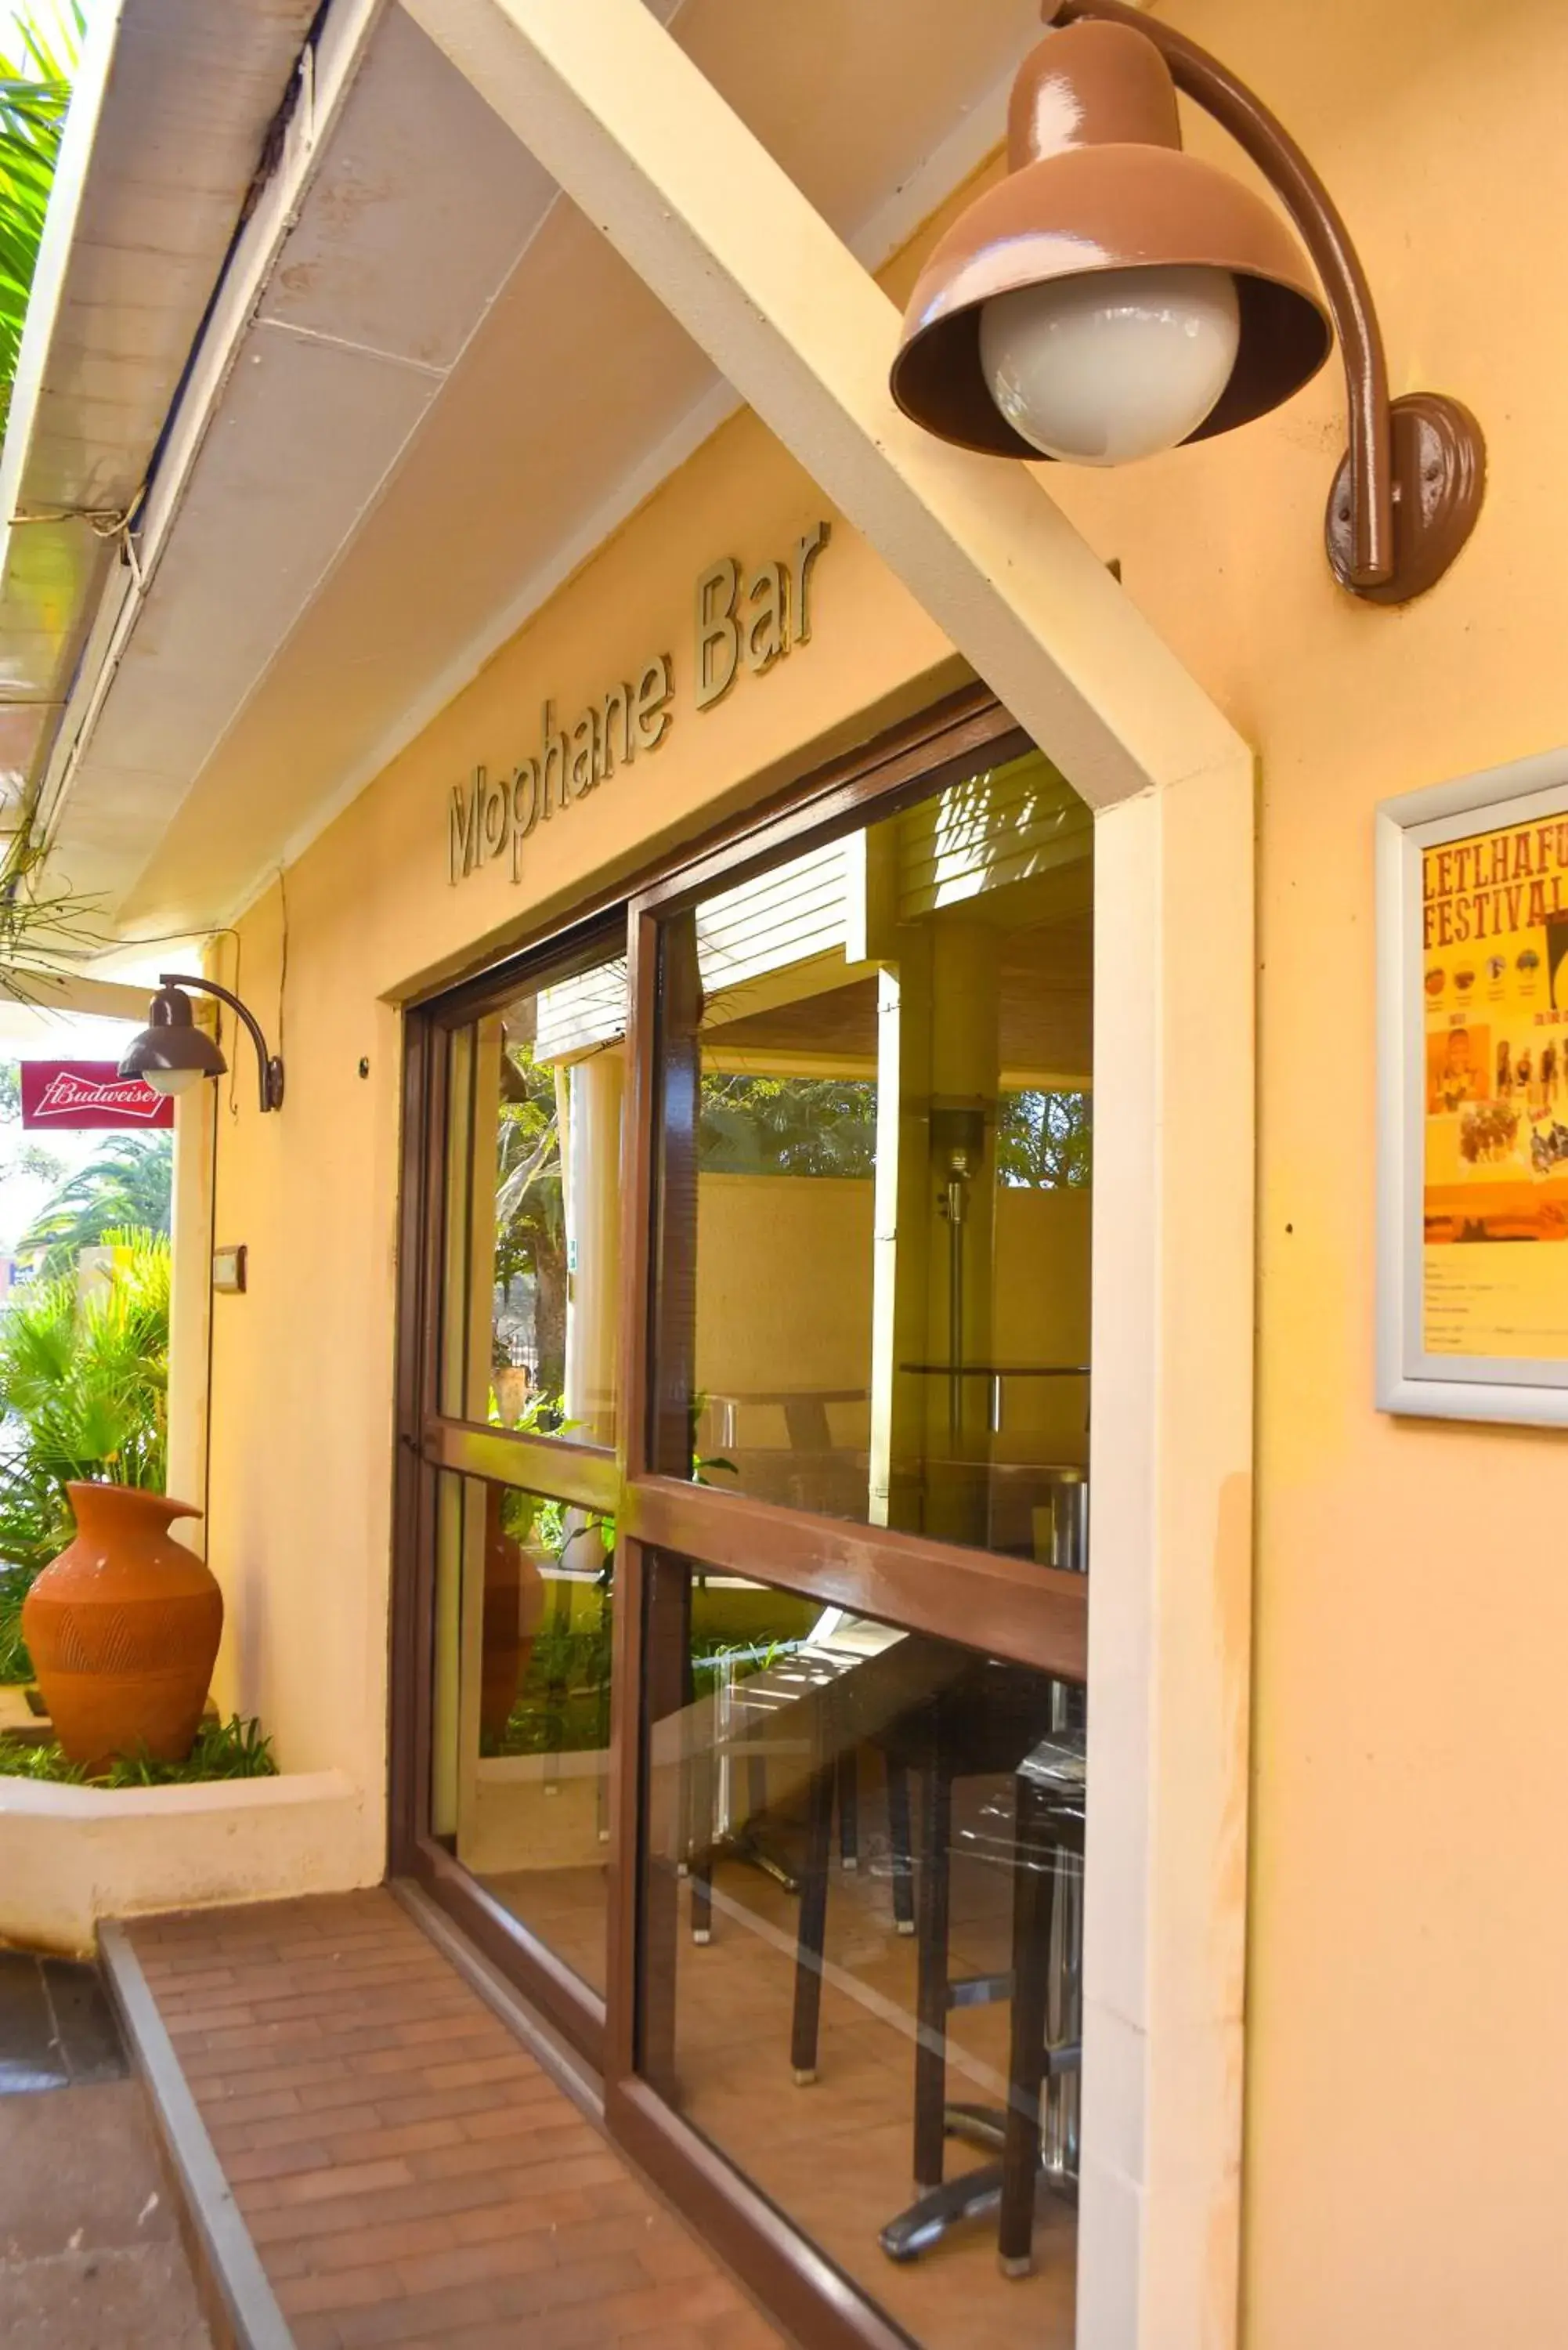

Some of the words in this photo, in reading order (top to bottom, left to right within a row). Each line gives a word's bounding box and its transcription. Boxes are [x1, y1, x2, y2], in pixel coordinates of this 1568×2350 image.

[449, 653, 676, 885] Mophane
[697, 521, 832, 713] Bar
[45, 1082, 168, 1104] Budweiser
